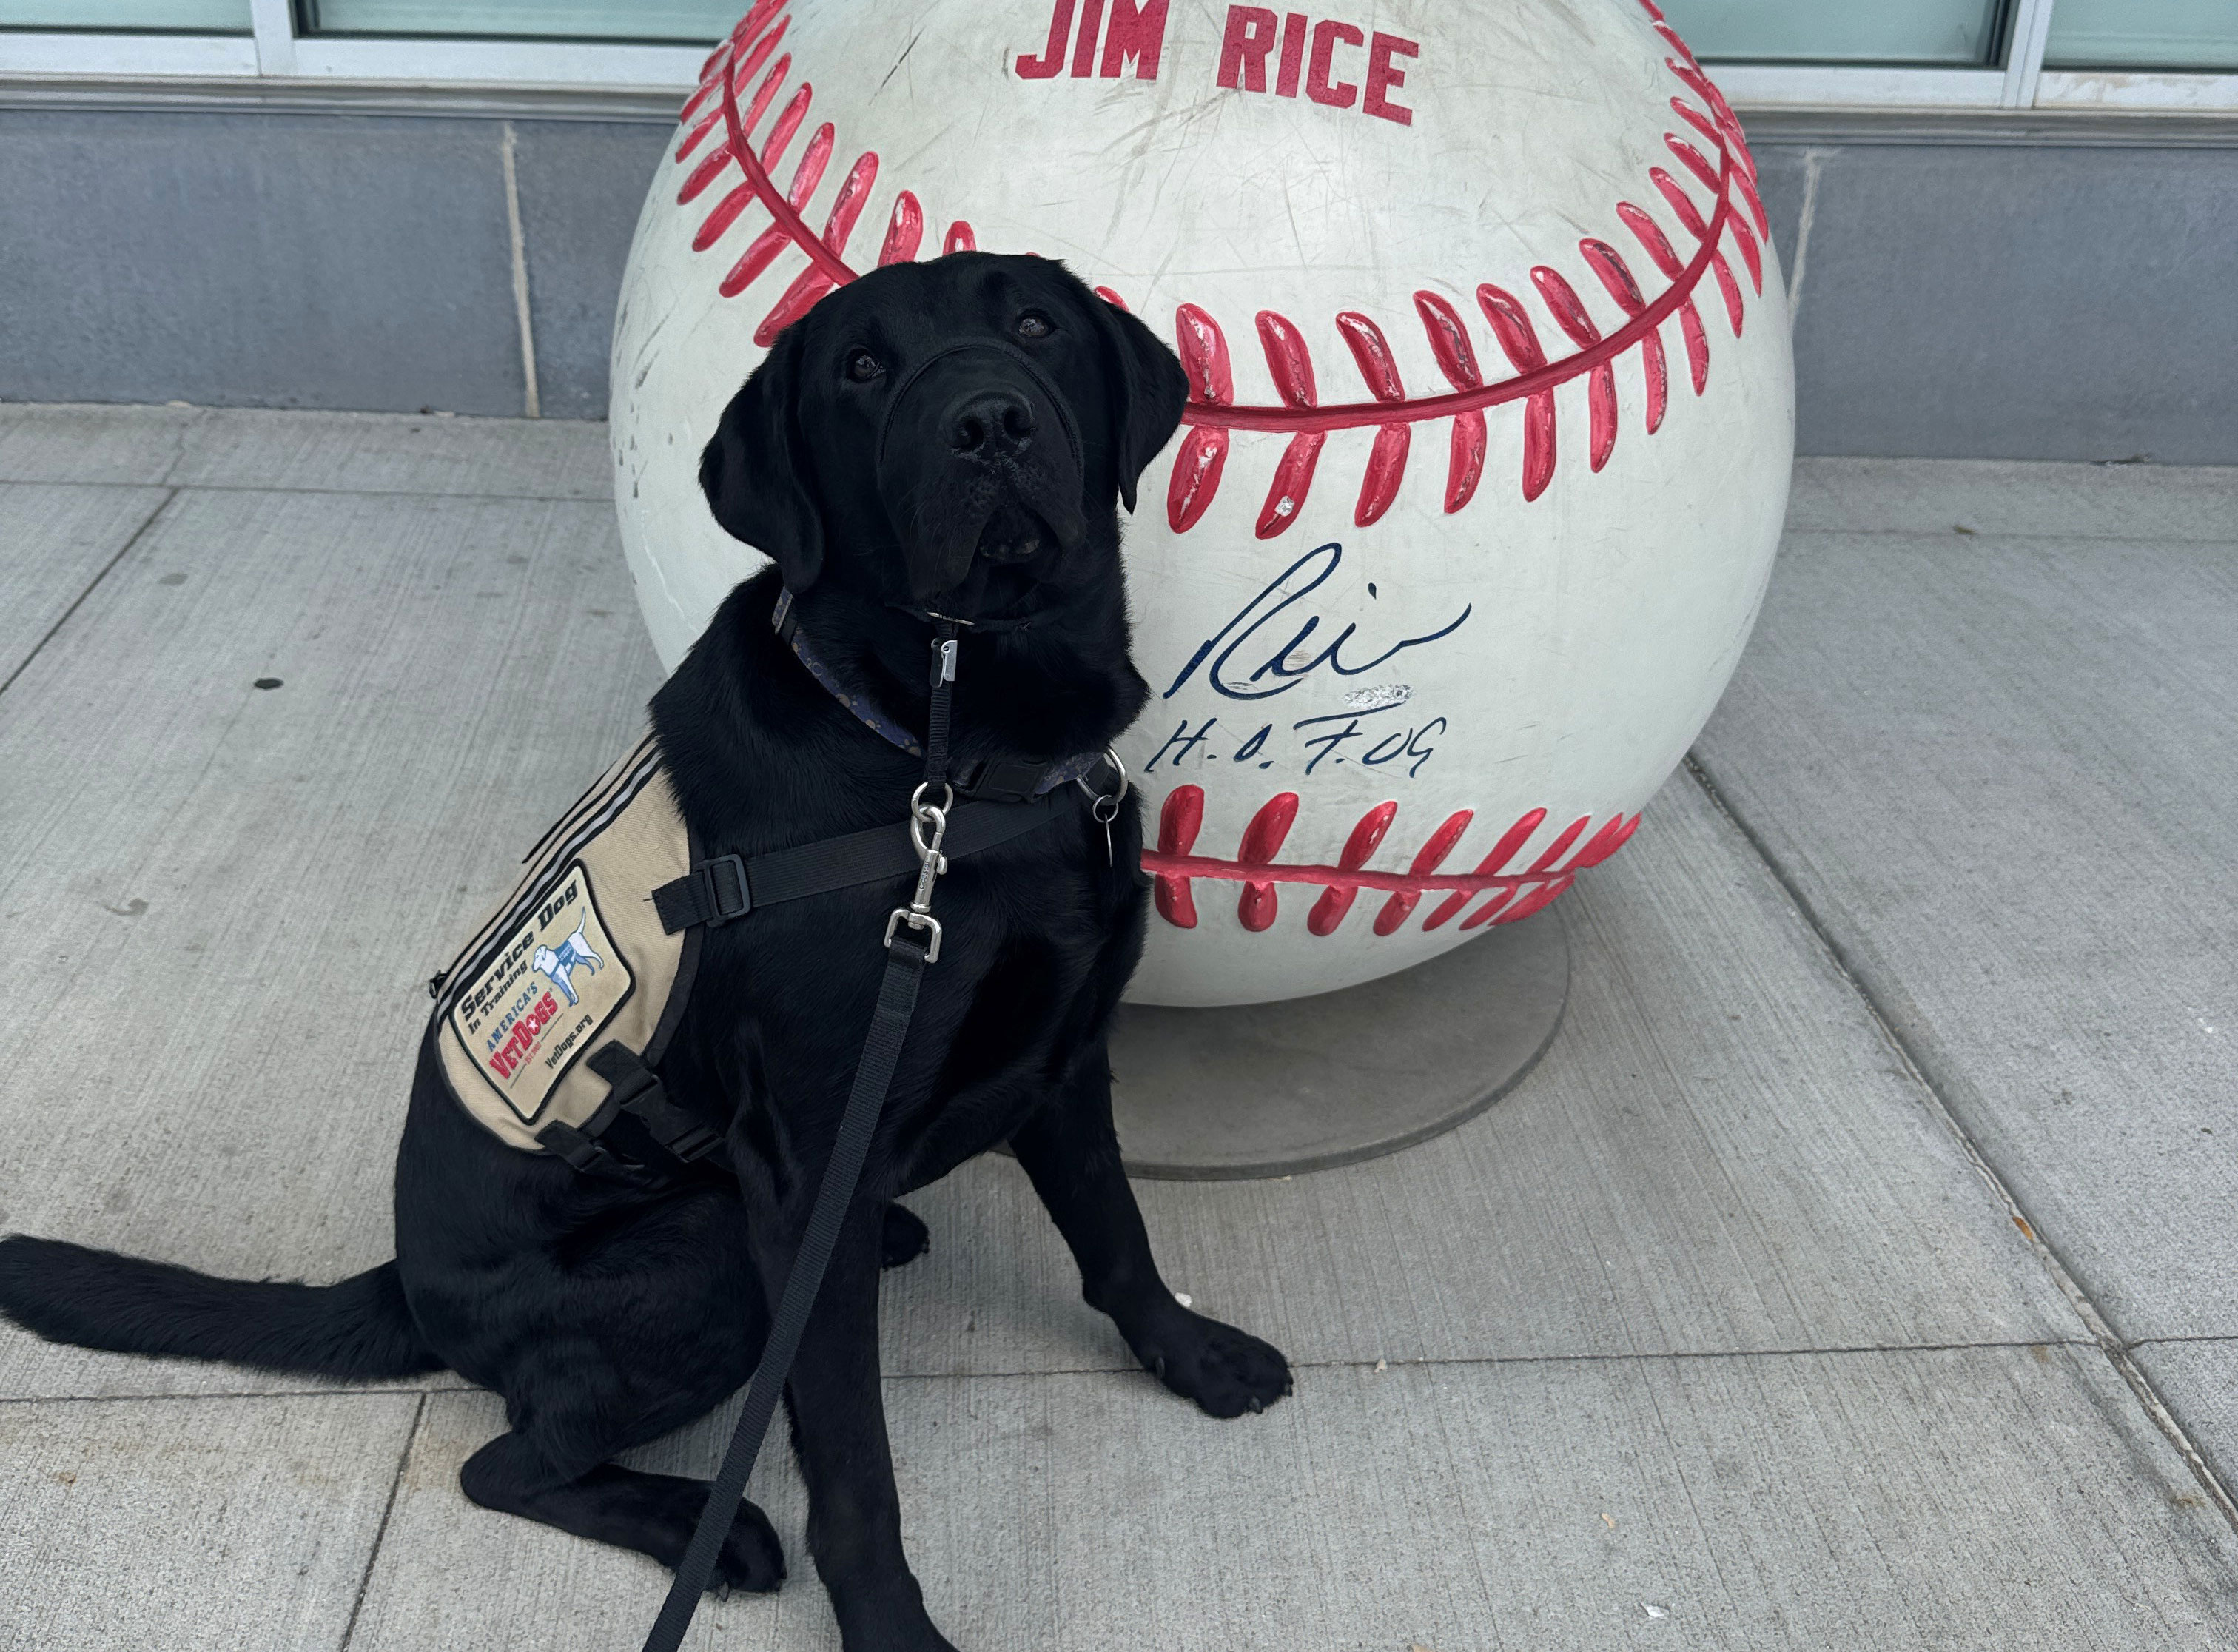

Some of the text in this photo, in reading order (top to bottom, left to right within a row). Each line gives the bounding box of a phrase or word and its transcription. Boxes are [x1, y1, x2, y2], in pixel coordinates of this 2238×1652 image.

[1015, 0, 1419, 127] JIM RICE
[461, 879, 578, 1021] Service Dog
[468, 959, 528, 1035] In Training
[486, 981, 538, 1052] AMERICA'S
[545, 1013, 594, 1070] VetDogs.org
